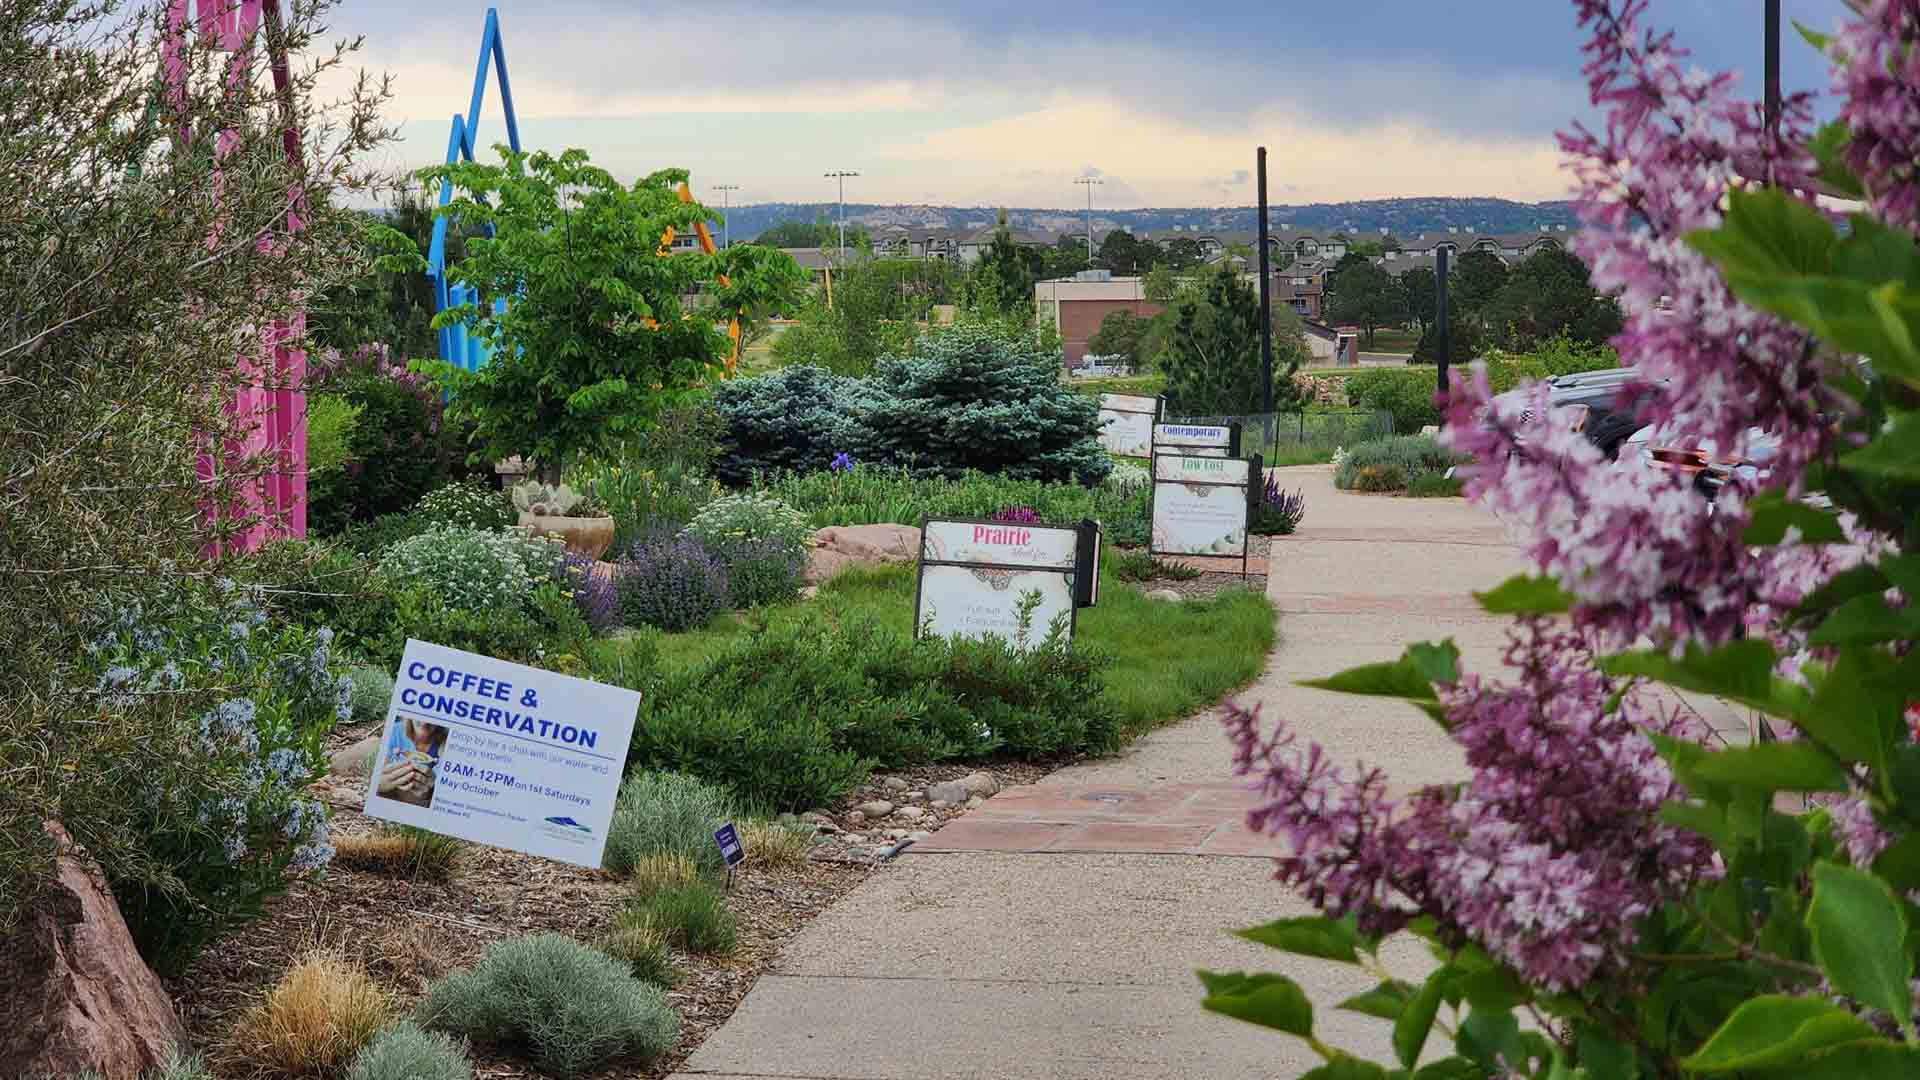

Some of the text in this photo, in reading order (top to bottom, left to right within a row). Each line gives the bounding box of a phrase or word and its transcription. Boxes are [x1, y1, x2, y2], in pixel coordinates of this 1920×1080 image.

[1162, 425, 1222, 438] Contemporary
[1182, 458, 1224, 472] Low Cost
[973, 526, 1031, 545] Prairie
[408, 662, 539, 708] COFFEE &
[401, 688, 598, 748] CONSERVATION
[515, 782, 527, 791] on
[529, 784, 542, 795] 1st
[544, 788, 591, 807] Saturdays
